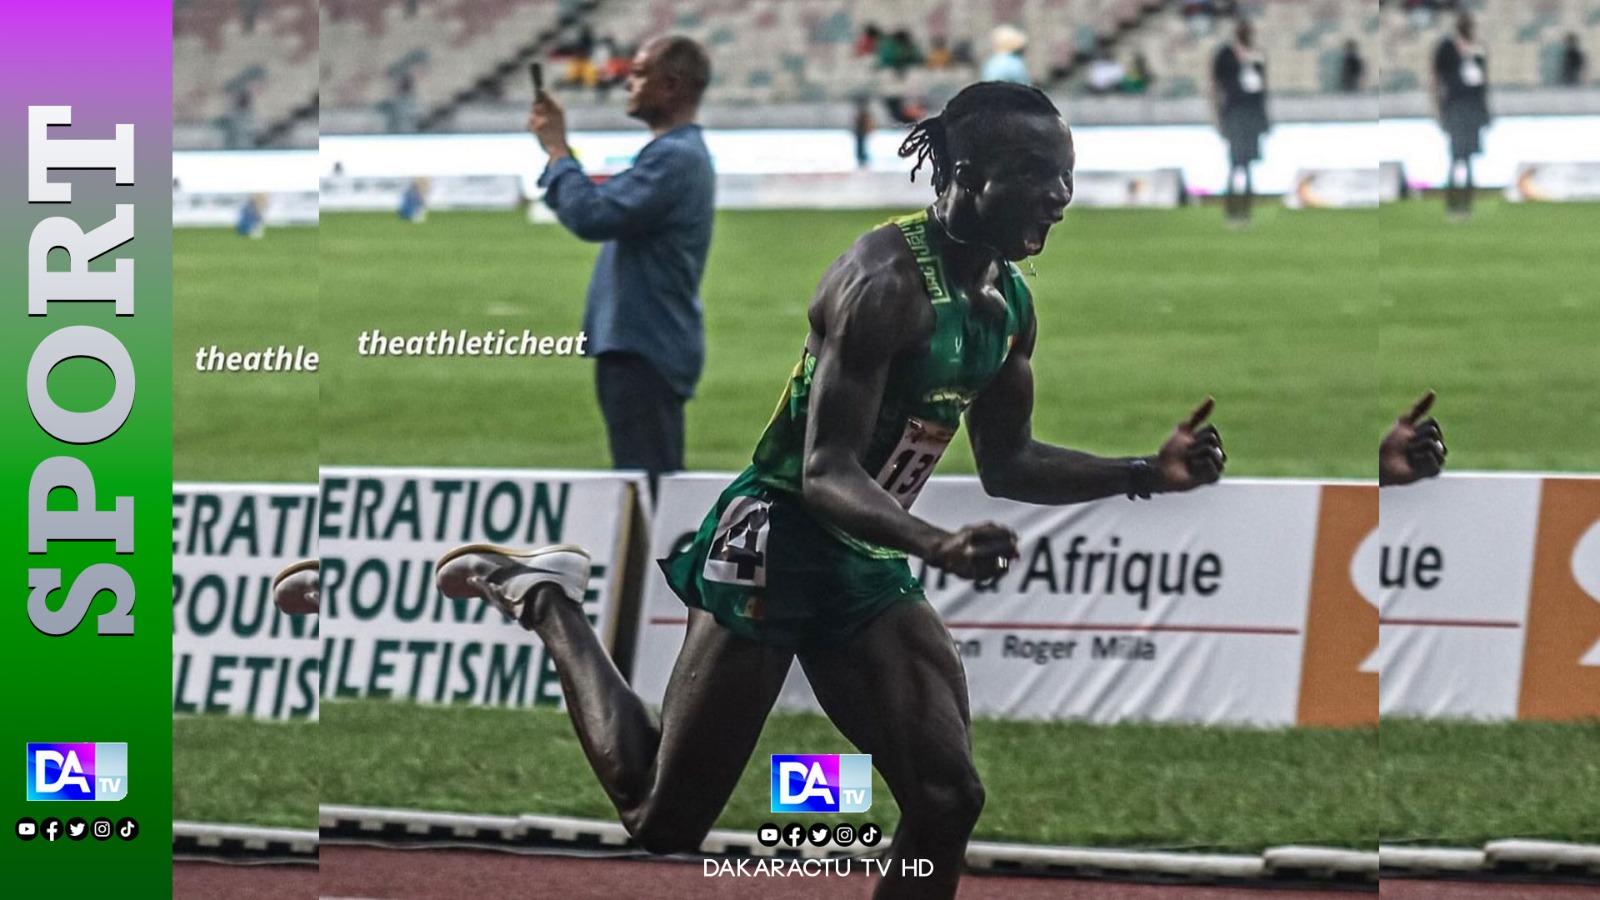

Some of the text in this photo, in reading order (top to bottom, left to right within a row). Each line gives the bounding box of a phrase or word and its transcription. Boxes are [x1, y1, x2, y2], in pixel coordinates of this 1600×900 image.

[319, 478, 571, 543] ERATION
[708, 508, 764, 580] 4
[1002, 634, 1077, 665] Roger
